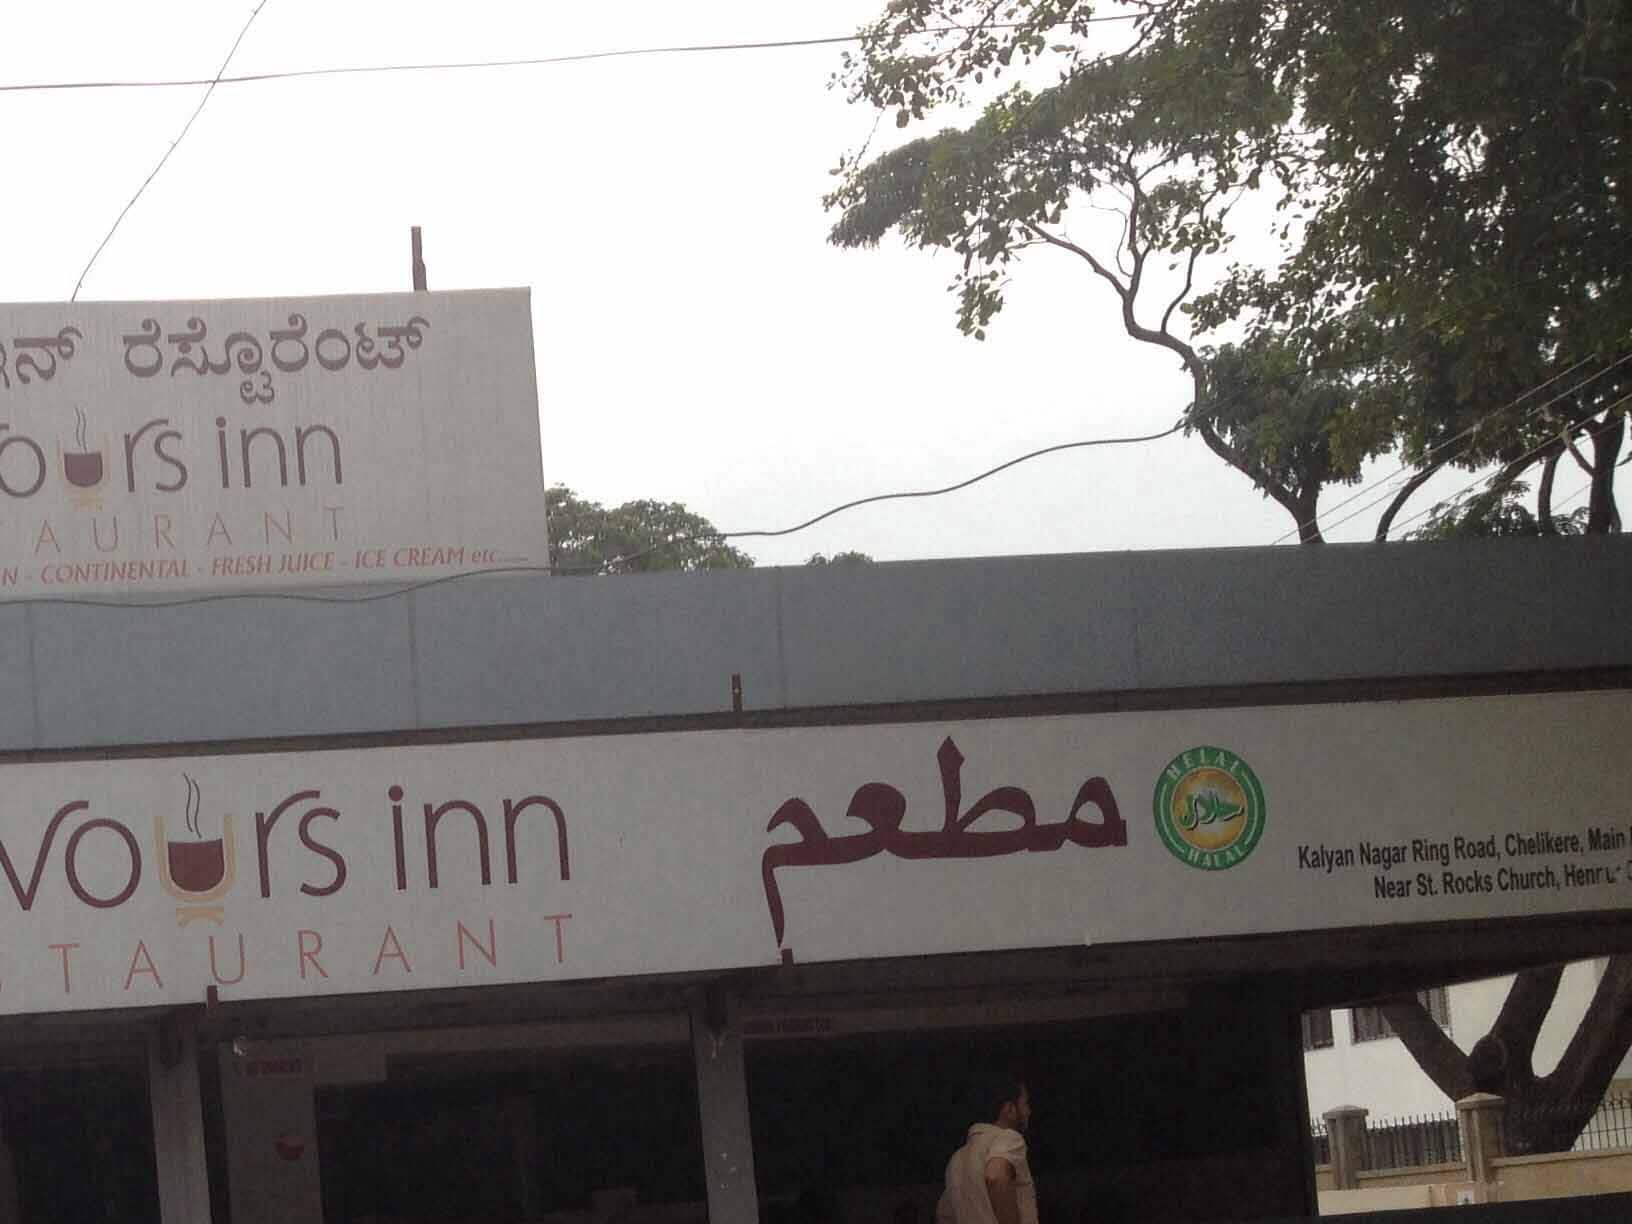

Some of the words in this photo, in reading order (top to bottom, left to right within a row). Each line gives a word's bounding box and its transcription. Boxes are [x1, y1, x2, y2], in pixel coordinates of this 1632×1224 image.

[215, 416, 344, 489] inn
[40, 558, 190, 585] CONTINENTAL
[212, 554, 272, 577] FRESH
[279, 551, 335, 574] JUICE
[354, 548, 385, 569] ICE
[393, 546, 464, 569] CREAM
[388, 785, 571, 891] inn
[761, 736, 1128, 948] مطعم
[1298, 844, 1355, 873] Kalyan
[1359, 842, 1408, 871] Nagar
[1411, 838, 1450, 867] Ring
[1453, 835, 1501, 861] Road,
[1504, 831, 1585, 857] Chelikere,
[1587, 826, 1626, 851] Main
[1373, 875, 1413, 899] Near
[1416, 872, 1438, 896] St.
[1442, 870, 1494, 895] Rocks
[1496, 865, 1561, 892] Church,
